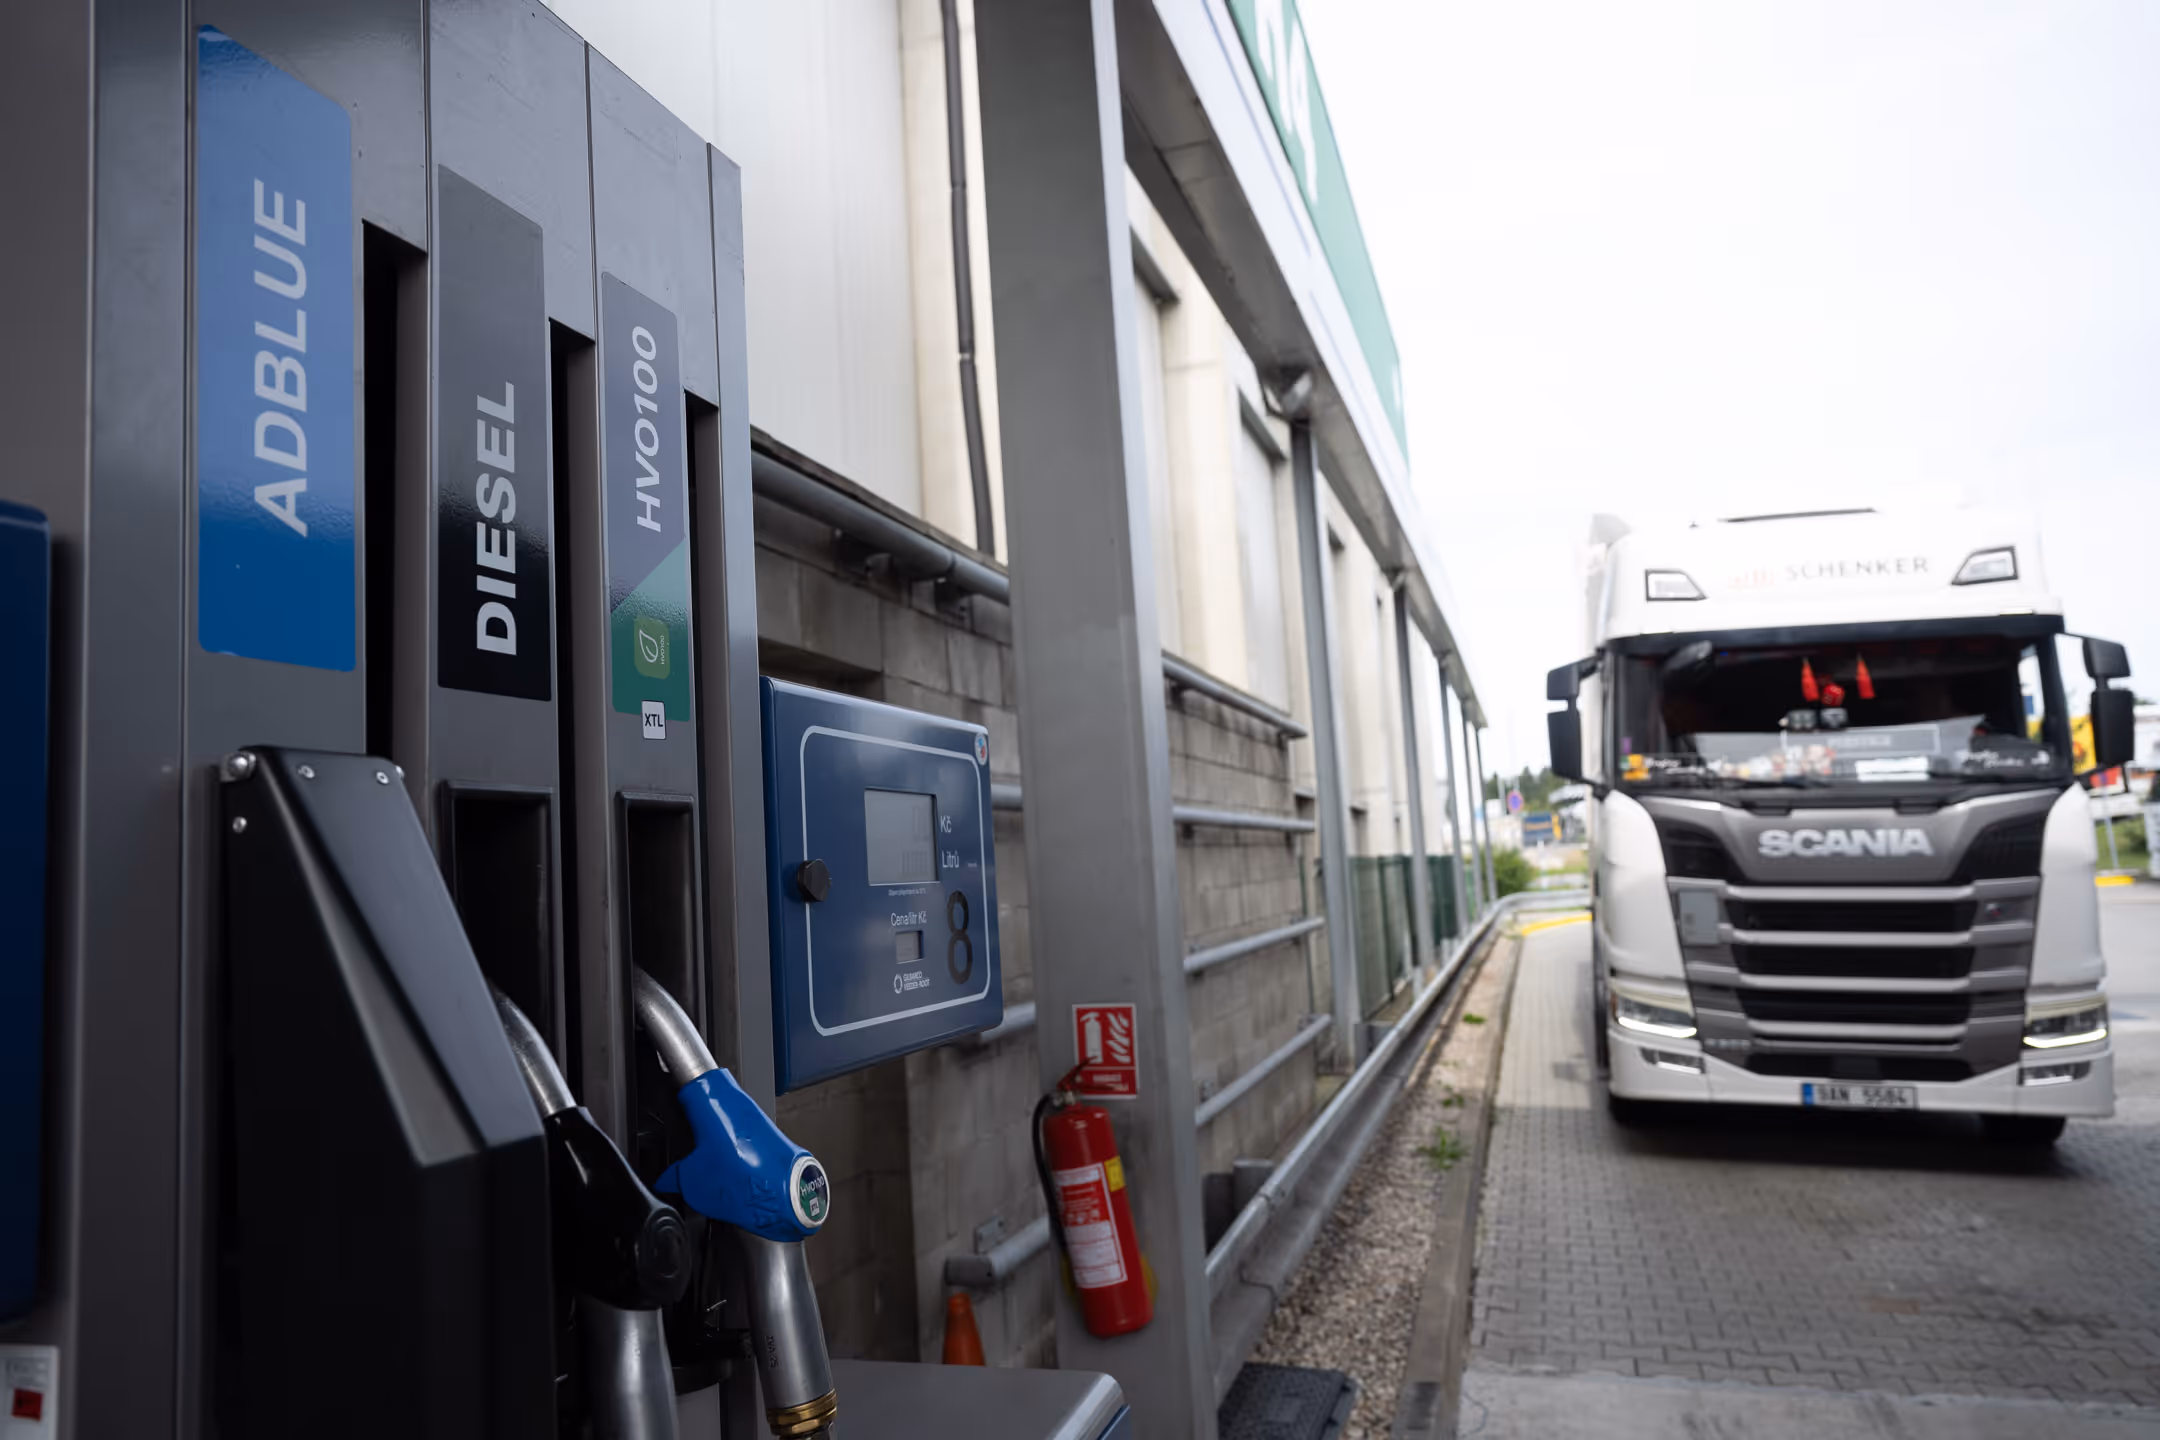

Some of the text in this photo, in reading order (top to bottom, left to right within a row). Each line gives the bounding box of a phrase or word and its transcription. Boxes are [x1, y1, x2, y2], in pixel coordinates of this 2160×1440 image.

[254, 177, 307, 538] ADBLUE
[632, 326, 661, 533] HVO100
[476, 381, 517, 656] DIESEL
[1786, 556, 1929, 582] SCHENKER
[644, 712, 664, 728] XTL
[940, 814, 952, 833] Kč
[1758, 828, 1935, 857] SCANIA
[941, 849, 960, 869] Litrů
[947, 890, 973, 985] 8
[800, 1175, 825, 1198] HVO100
